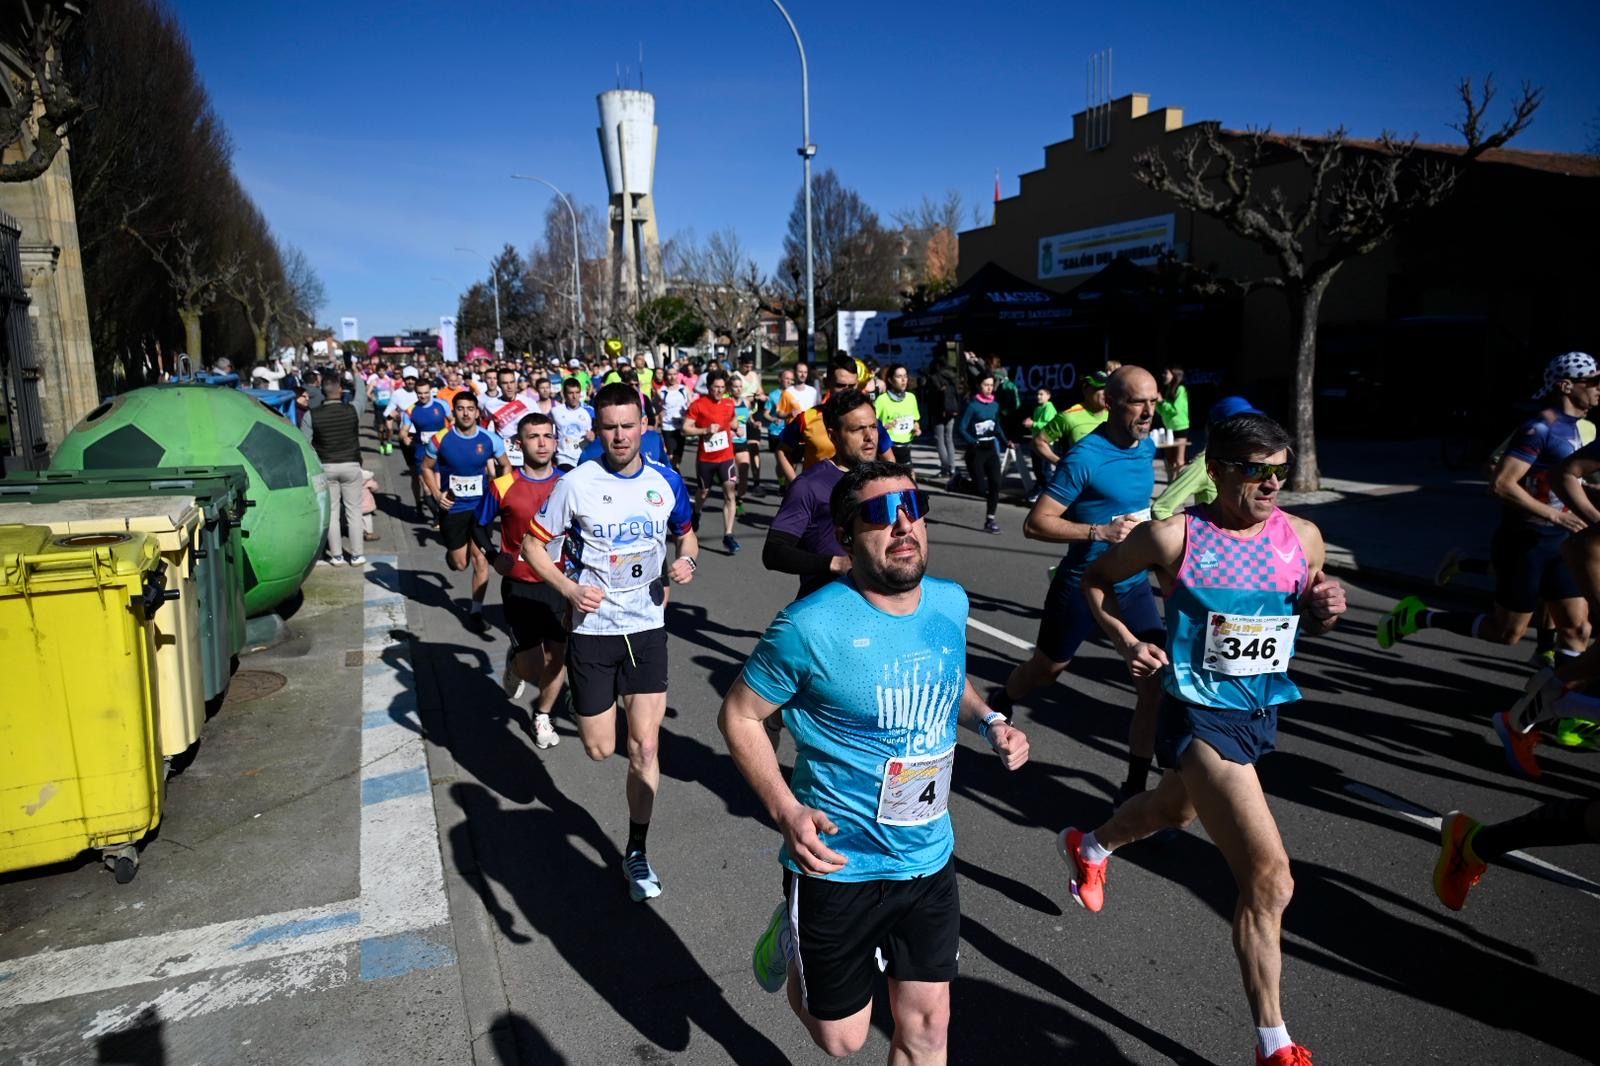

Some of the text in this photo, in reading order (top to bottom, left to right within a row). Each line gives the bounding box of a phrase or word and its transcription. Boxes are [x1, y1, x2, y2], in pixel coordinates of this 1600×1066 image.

[455, 483, 476, 491] 314
[631, 564, 643, 578] 8
[1221, 637, 1277, 660] 346
[918, 780, 936, 805] 4
